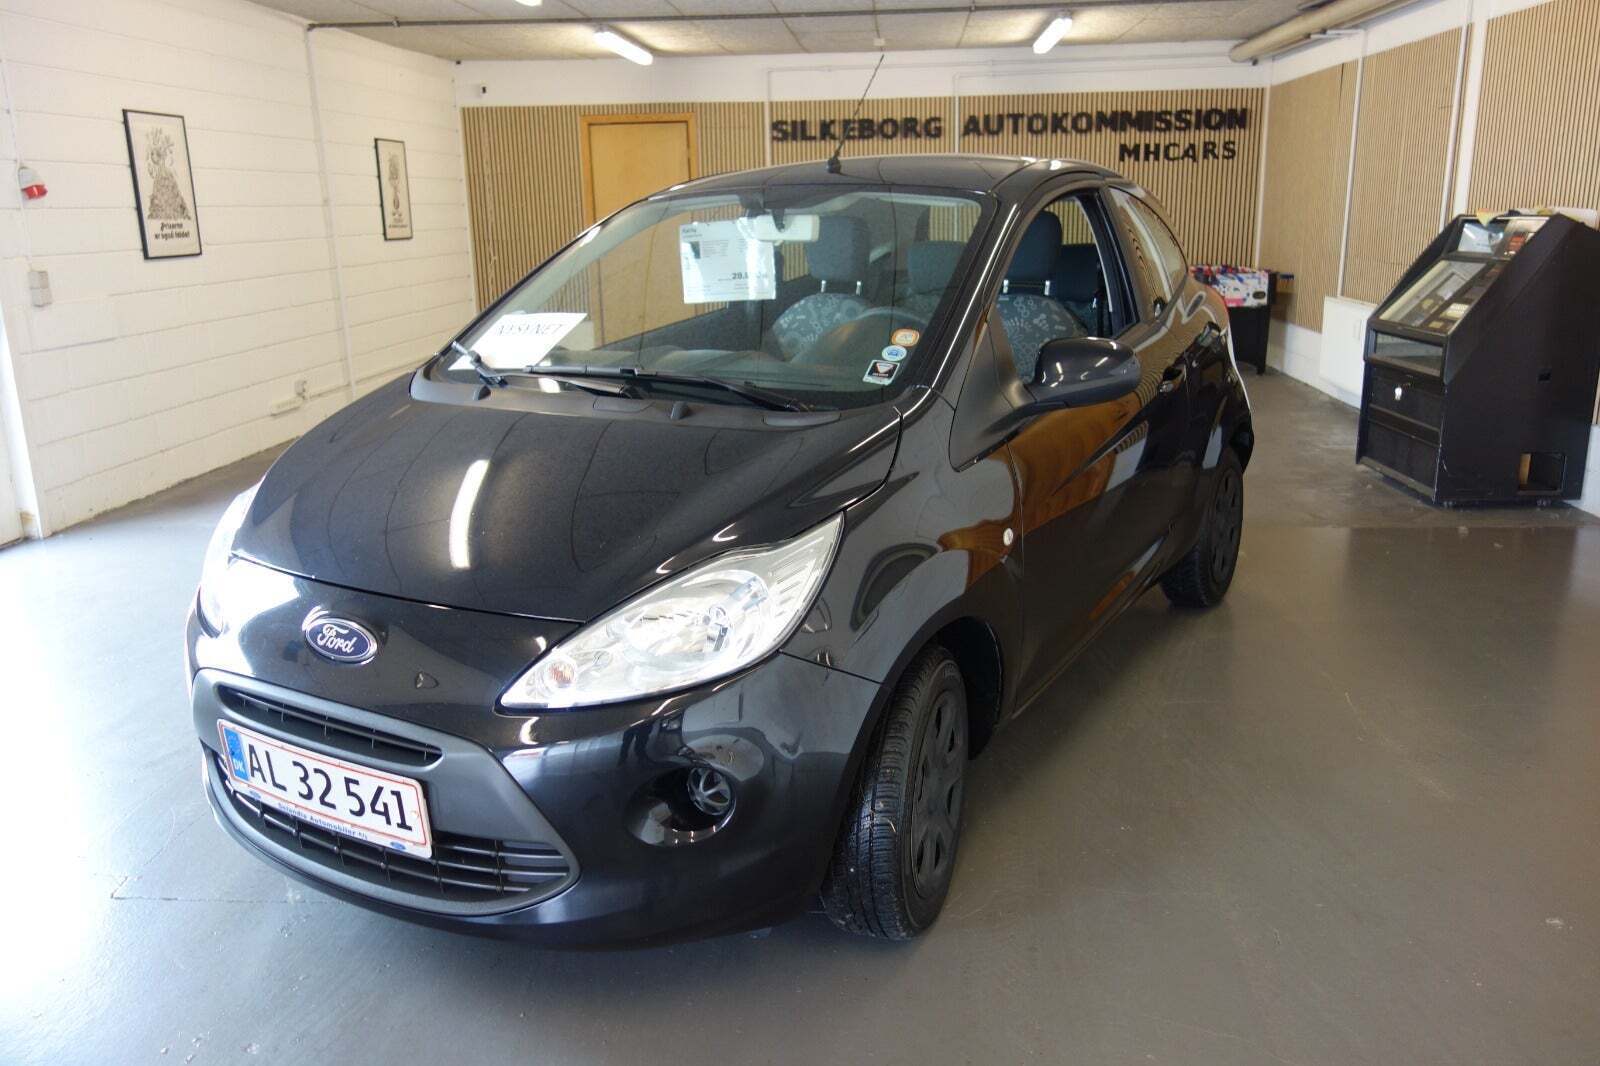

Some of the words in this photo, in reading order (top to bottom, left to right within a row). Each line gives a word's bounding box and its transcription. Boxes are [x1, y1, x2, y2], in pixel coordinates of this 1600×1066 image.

[772, 117, 942, 143] SILKEBORG
[962, 108, 1247, 137] AUTOKOMMISSION
[1119, 141, 1236, 163] MHCARS
[317, 623, 358, 654] Ford
[248, 744, 287, 792] AL
[292, 760, 336, 810] 32
[344, 776, 413, 832] 541
